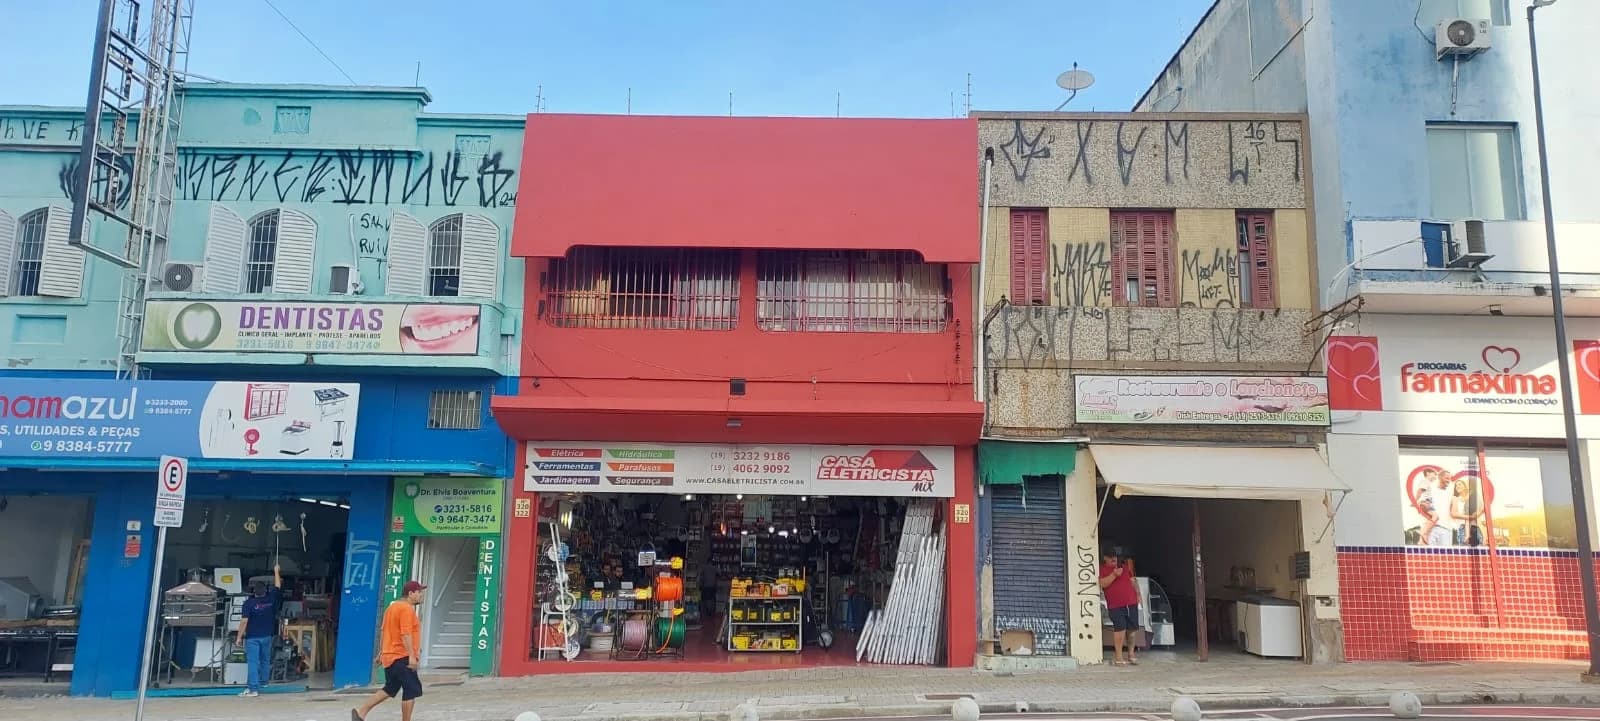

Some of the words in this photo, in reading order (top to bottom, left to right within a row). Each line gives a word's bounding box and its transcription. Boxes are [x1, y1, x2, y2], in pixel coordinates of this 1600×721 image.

[239, 306, 384, 331] DENTISTAS
[1417, 362, 1467, 371] DROGARIAS
[1118, 378, 1213, 397] Restaurante
[1230, 379, 1318, 398] Lanchonete
[1517, 398, 1523, 406] O
[1523, 397, 1558, 407] CORAÇÃO
[1191, 411, 1222, 423] Entregas
[15, 425, 85, 437] UTILIDADES
[88, 427, 99, 437] &
[101, 426, 141, 441] PEÇAS
[43, 440, 52, 452] 9
[56, 440, 132, 453] 8384-5777
[551, 449, 584, 457] Elétrica
[619, 449, 663, 458] Hidráulica
[710, 451, 726, 460] (19)
[733, 451, 760, 461] 3232
[763, 451, 790, 461] 9186
[538, 462, 594, 470] Ferramentas
[618, 463, 662, 471] Parafusos
[822, 455, 876, 469] CASA
[710, 464, 726, 473] (19)
[733, 464, 760, 474] 4062
[763, 464, 790, 474] 9092
[817, 467, 935, 481] ELETRICISTA
[169, 466, 178, 485] E
[539, 476, 591, 485] Jardinagem
[615, 477, 661, 486] Segurança
[420, 488, 430, 496] Dr.
[433, 488, 451, 496] Elvis
[453, 488, 496, 496] Boaventura
[443, 504, 492, 514] 3231-5816
[438, 515, 445, 524] 9
[447, 515, 497, 524] 9647-3474
[390, 539, 404, 605] DENTI
[478, 540, 495, 650] DENTISTAS
